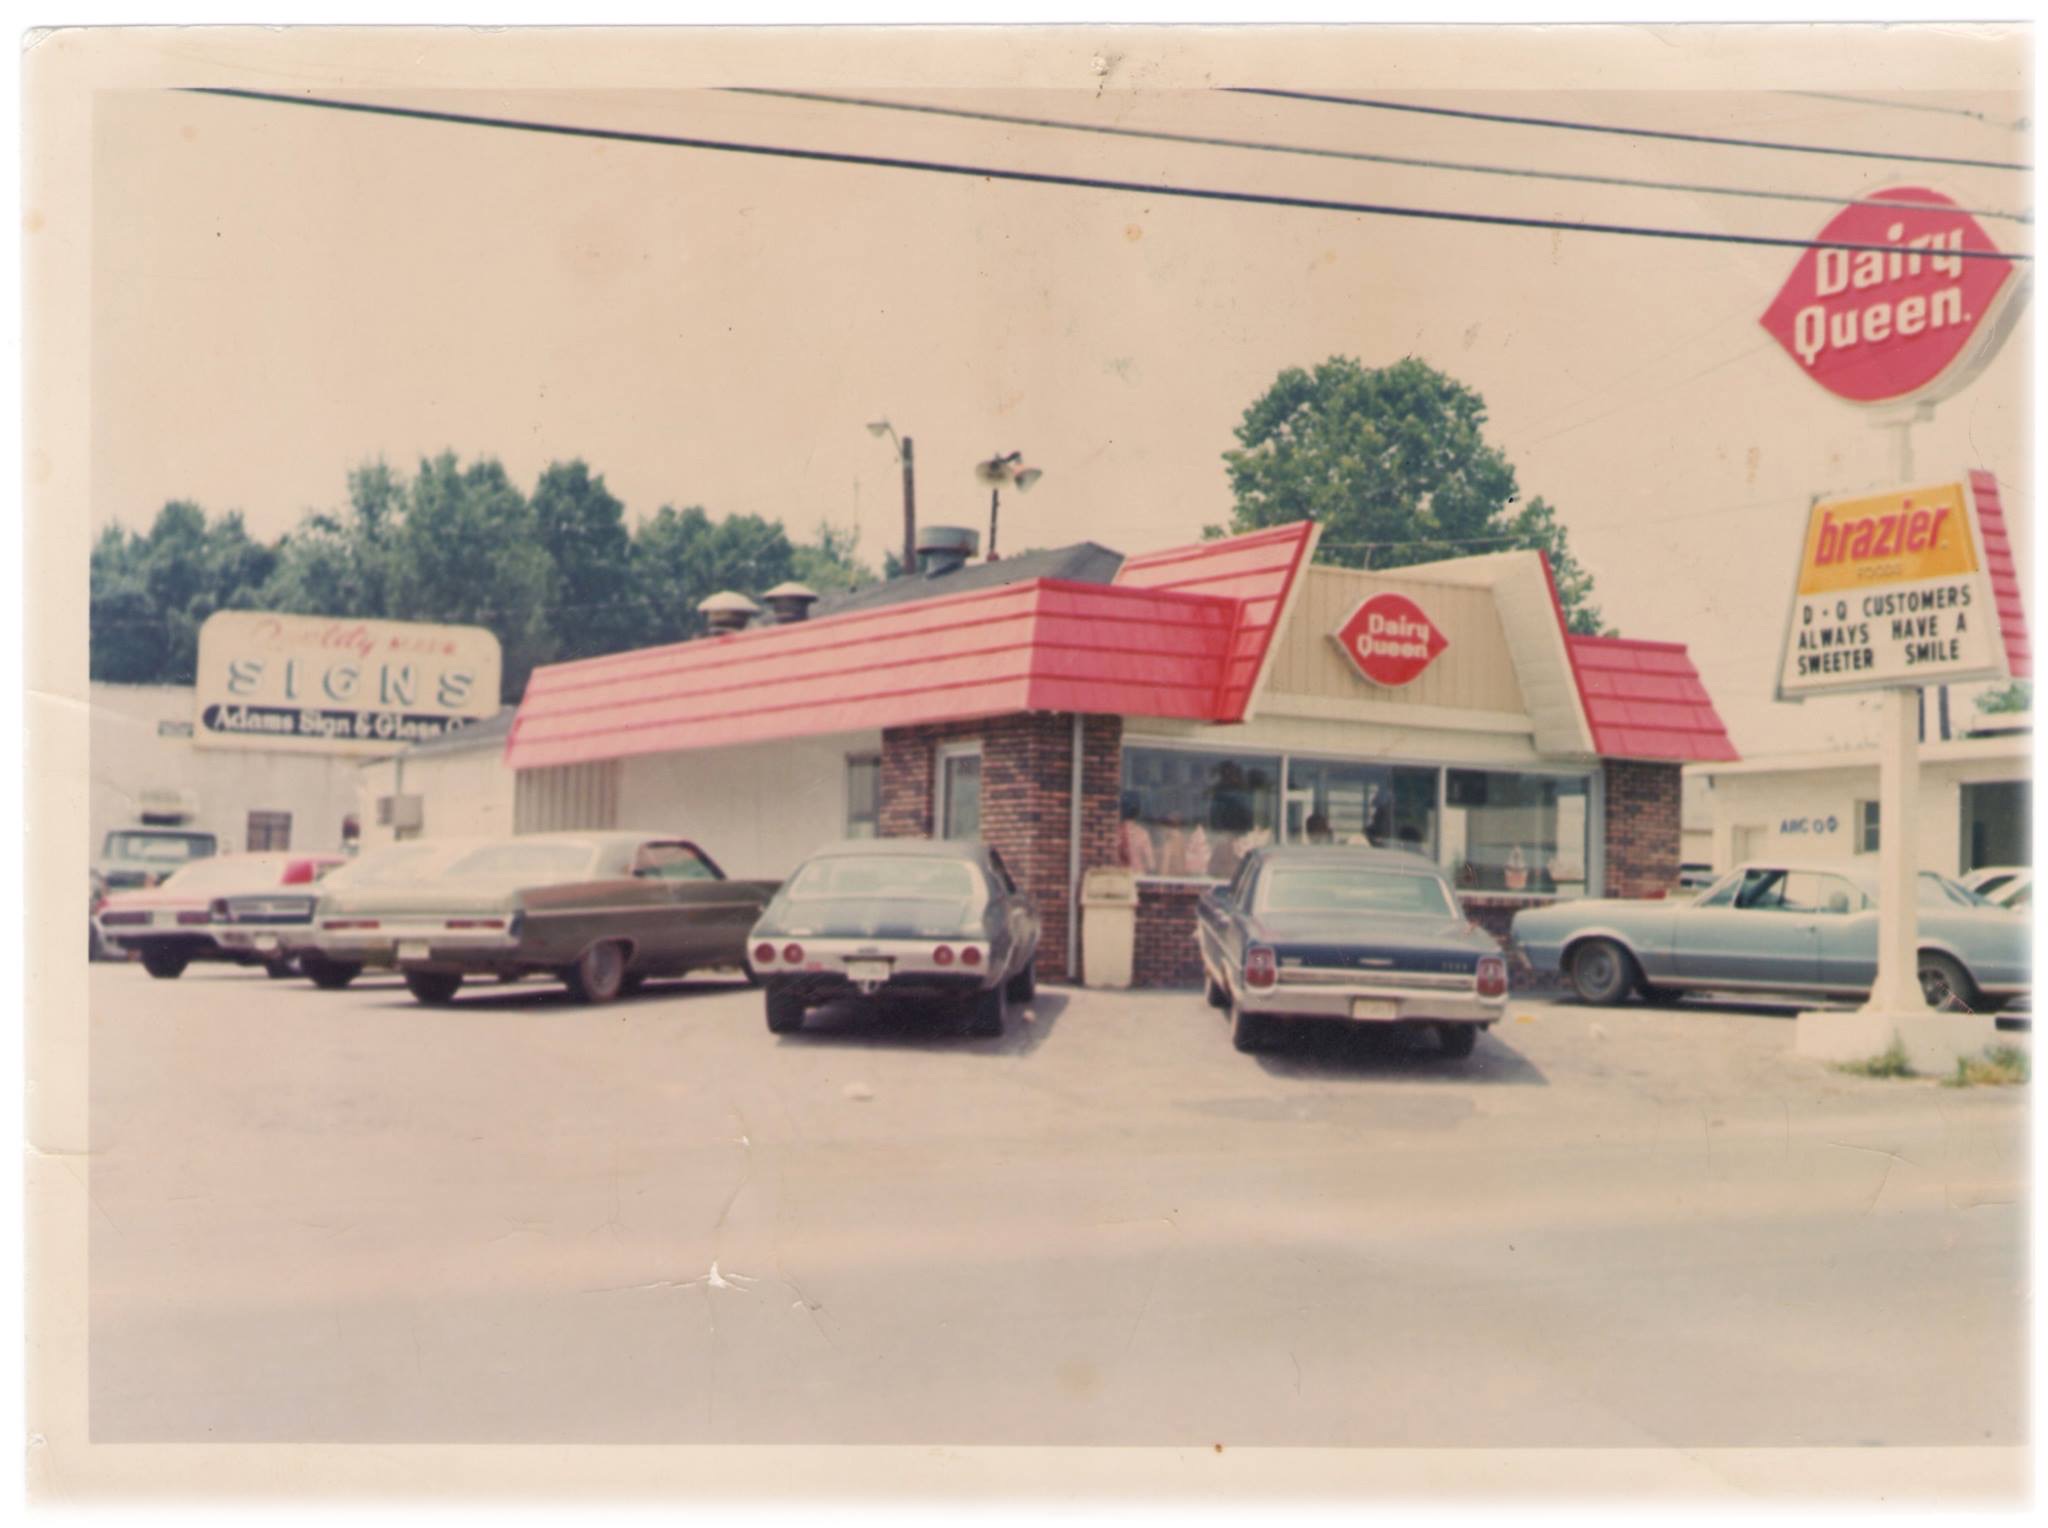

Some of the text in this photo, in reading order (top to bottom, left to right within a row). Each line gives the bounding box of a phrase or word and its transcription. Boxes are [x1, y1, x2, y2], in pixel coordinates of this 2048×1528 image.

[1816, 222, 1964, 296] Dairy
[1813, 499, 1952, 567] brazier
[1862, 584, 1972, 618] CUSTOMERS
[252, 617, 375, 658] Qlity
[1356, 633, 1428, 659] Queen
[1368, 613, 1430, 644] Dairy
[1797, 612, 1968, 651] ALWAYS HAVE A
[1797, 639, 1960, 676] SWEETER SMILE
[227, 656, 475, 709] SIGNS
[214, 706, 294, 732] Adams
[300, 708, 350, 738] Sign
